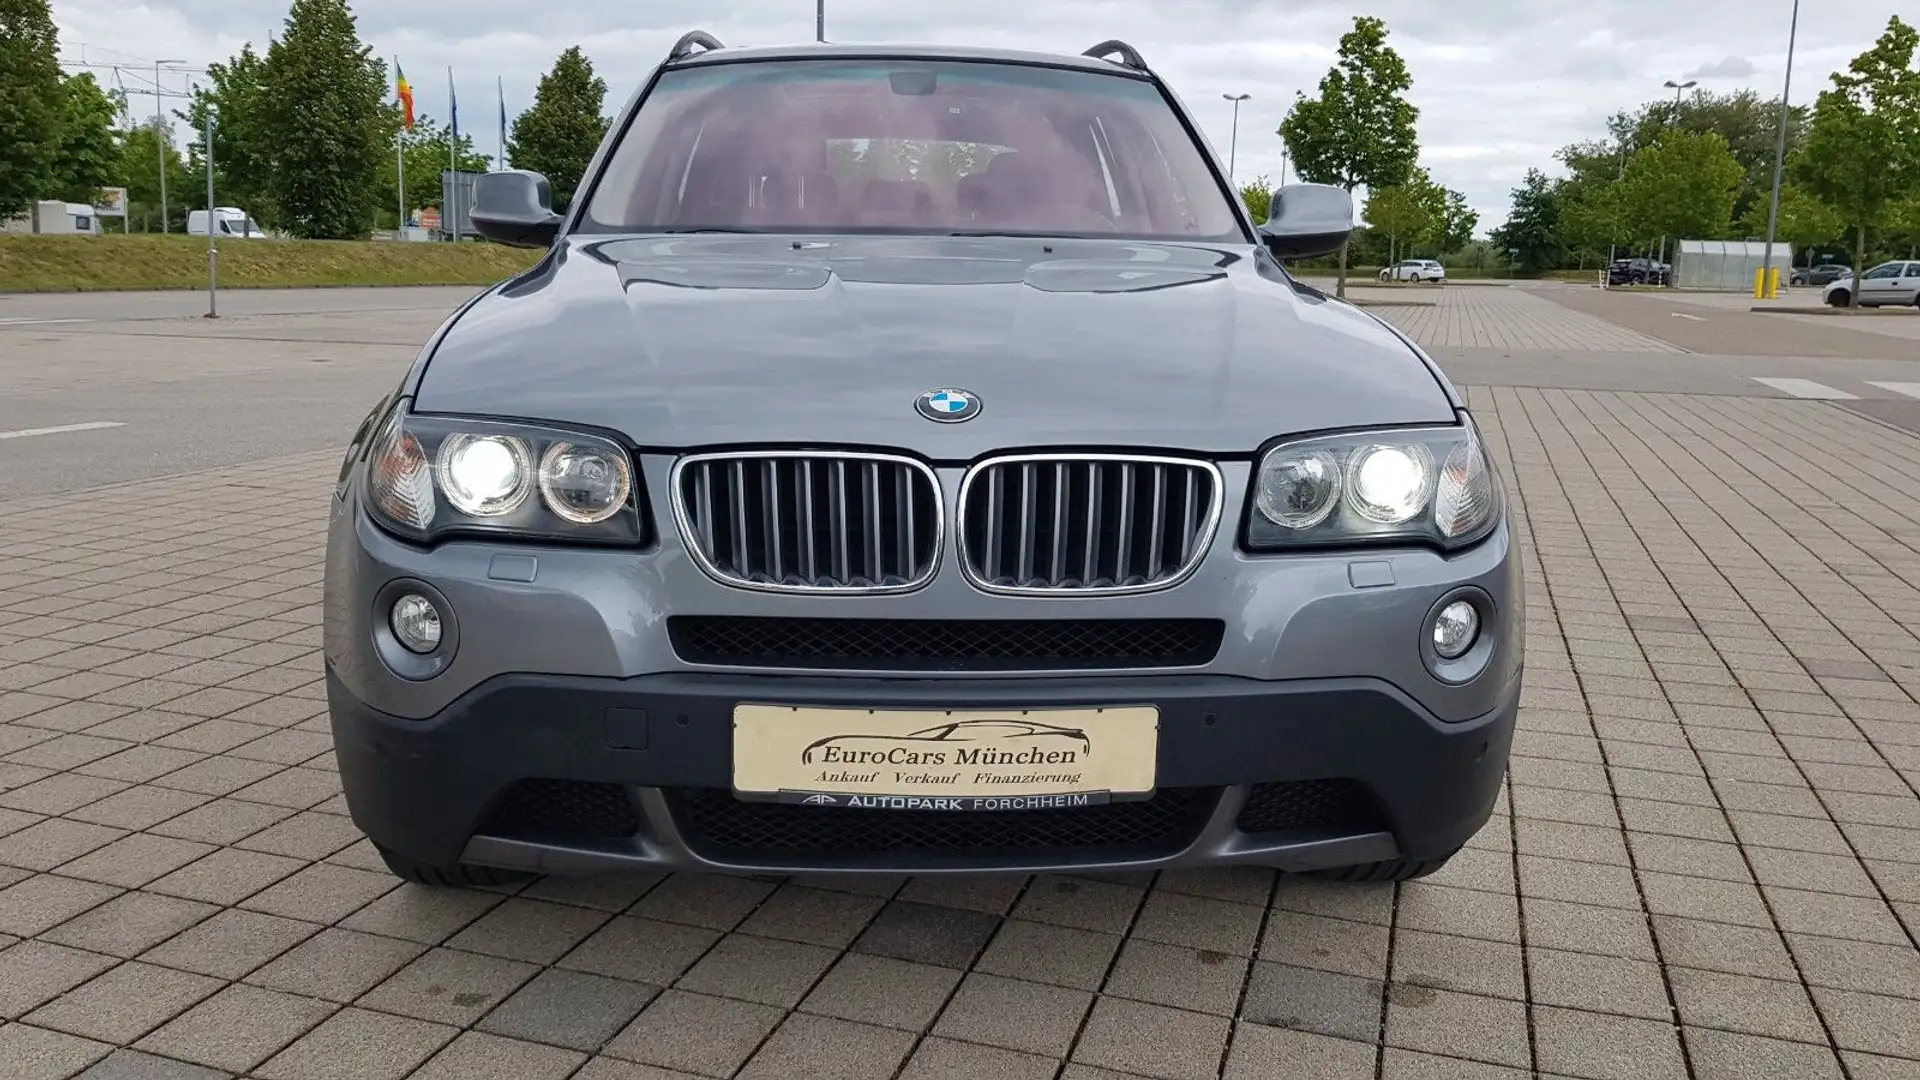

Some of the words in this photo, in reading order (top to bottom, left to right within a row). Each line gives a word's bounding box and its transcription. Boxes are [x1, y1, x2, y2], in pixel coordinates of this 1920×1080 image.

[821, 746, 946, 765] EuroCars
[953, 747, 1076, 765] München
[814, 771, 880, 783] Ankauf
[894, 772, 961, 784] Verkauf
[973, 772, 1082, 784] Finanzierung
[847, 795, 963, 810] AUTOPARK
[974, 795, 1088, 810] FORCHHEIM
